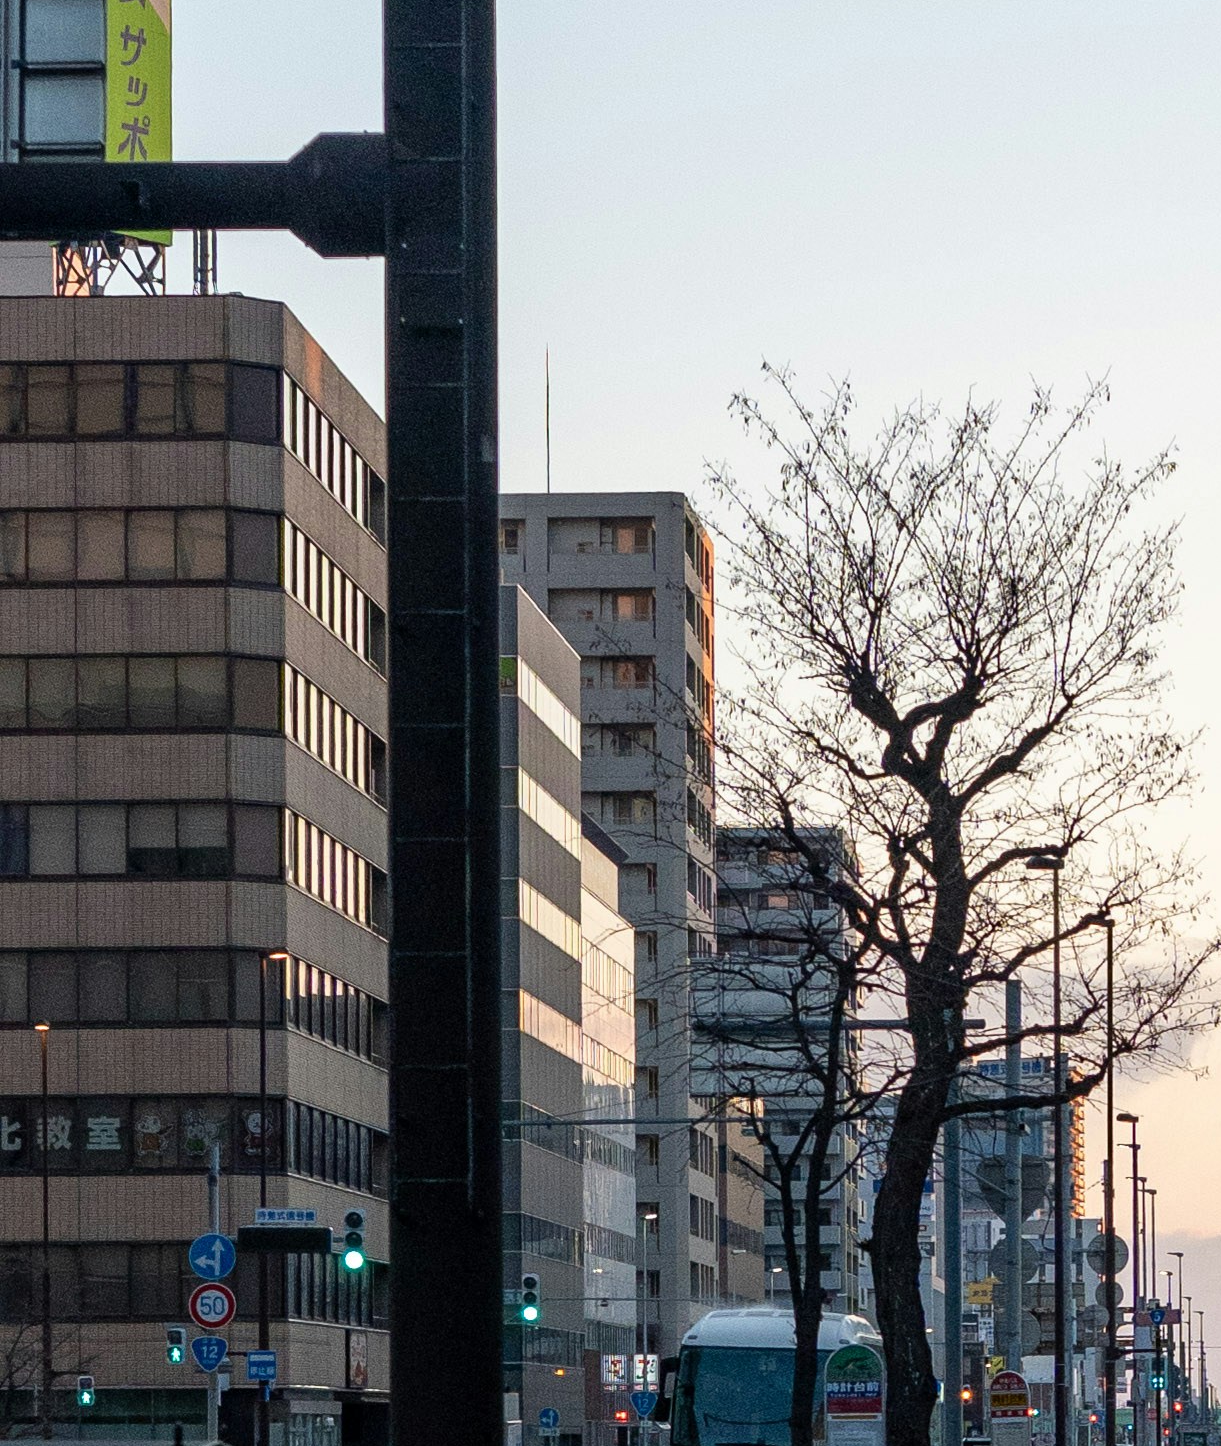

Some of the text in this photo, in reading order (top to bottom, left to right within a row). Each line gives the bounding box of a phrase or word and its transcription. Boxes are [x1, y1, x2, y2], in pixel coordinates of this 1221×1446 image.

[200, 1296, 225, 1315] 50
[1154, 1312, 1161, 1322] 5
[202, 1346, 218, 1358] 12
[639, 1398, 649, 1408] 12
